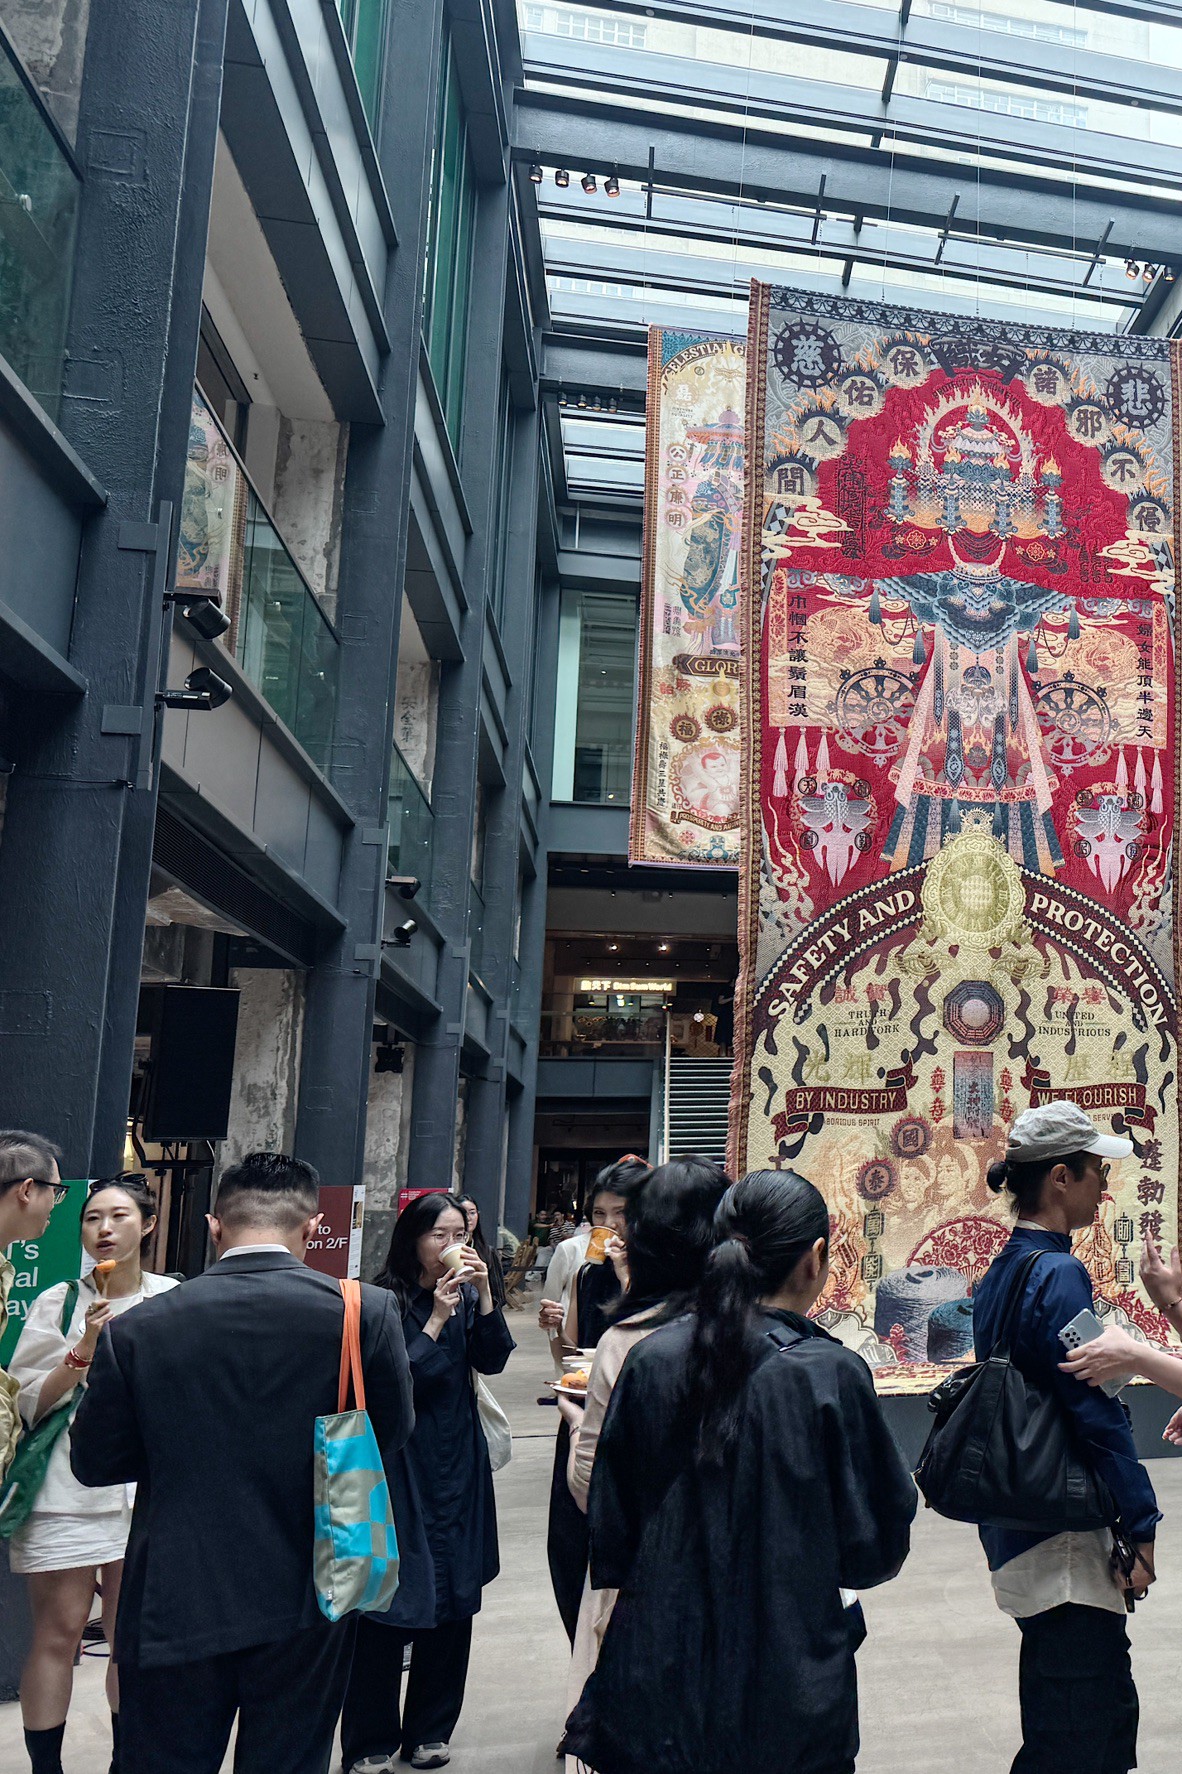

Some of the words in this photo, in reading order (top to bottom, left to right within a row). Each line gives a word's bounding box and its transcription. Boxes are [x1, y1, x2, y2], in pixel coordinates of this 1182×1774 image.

[890, 348, 920, 377] 保
[843, 379, 876, 406] 佑
[1121, 379, 1150, 416] 悲
[807, 419, 838, 446] 人
[1033, 367, 1059, 396] 諸
[1075, 409, 1102, 439] 邪
[1110, 458, 1136, 482] 不
[777, 467, 804, 496] 間
[768, 918, 852, 1020] SAFETY
[858, 890, 915, 932] AND
[1030, 893, 1168, 1026] PROTECTION
[1055, 1011, 1095, 1020] UNTED
[796, 1091, 814, 1110] BY
[820, 1091, 897, 1110] INDUSTRY
[1137, 1138, 1166, 1265] 蓬勃發
[317, 1224, 331, 1235] to
[326, 1237, 348, 1249] 2/F
